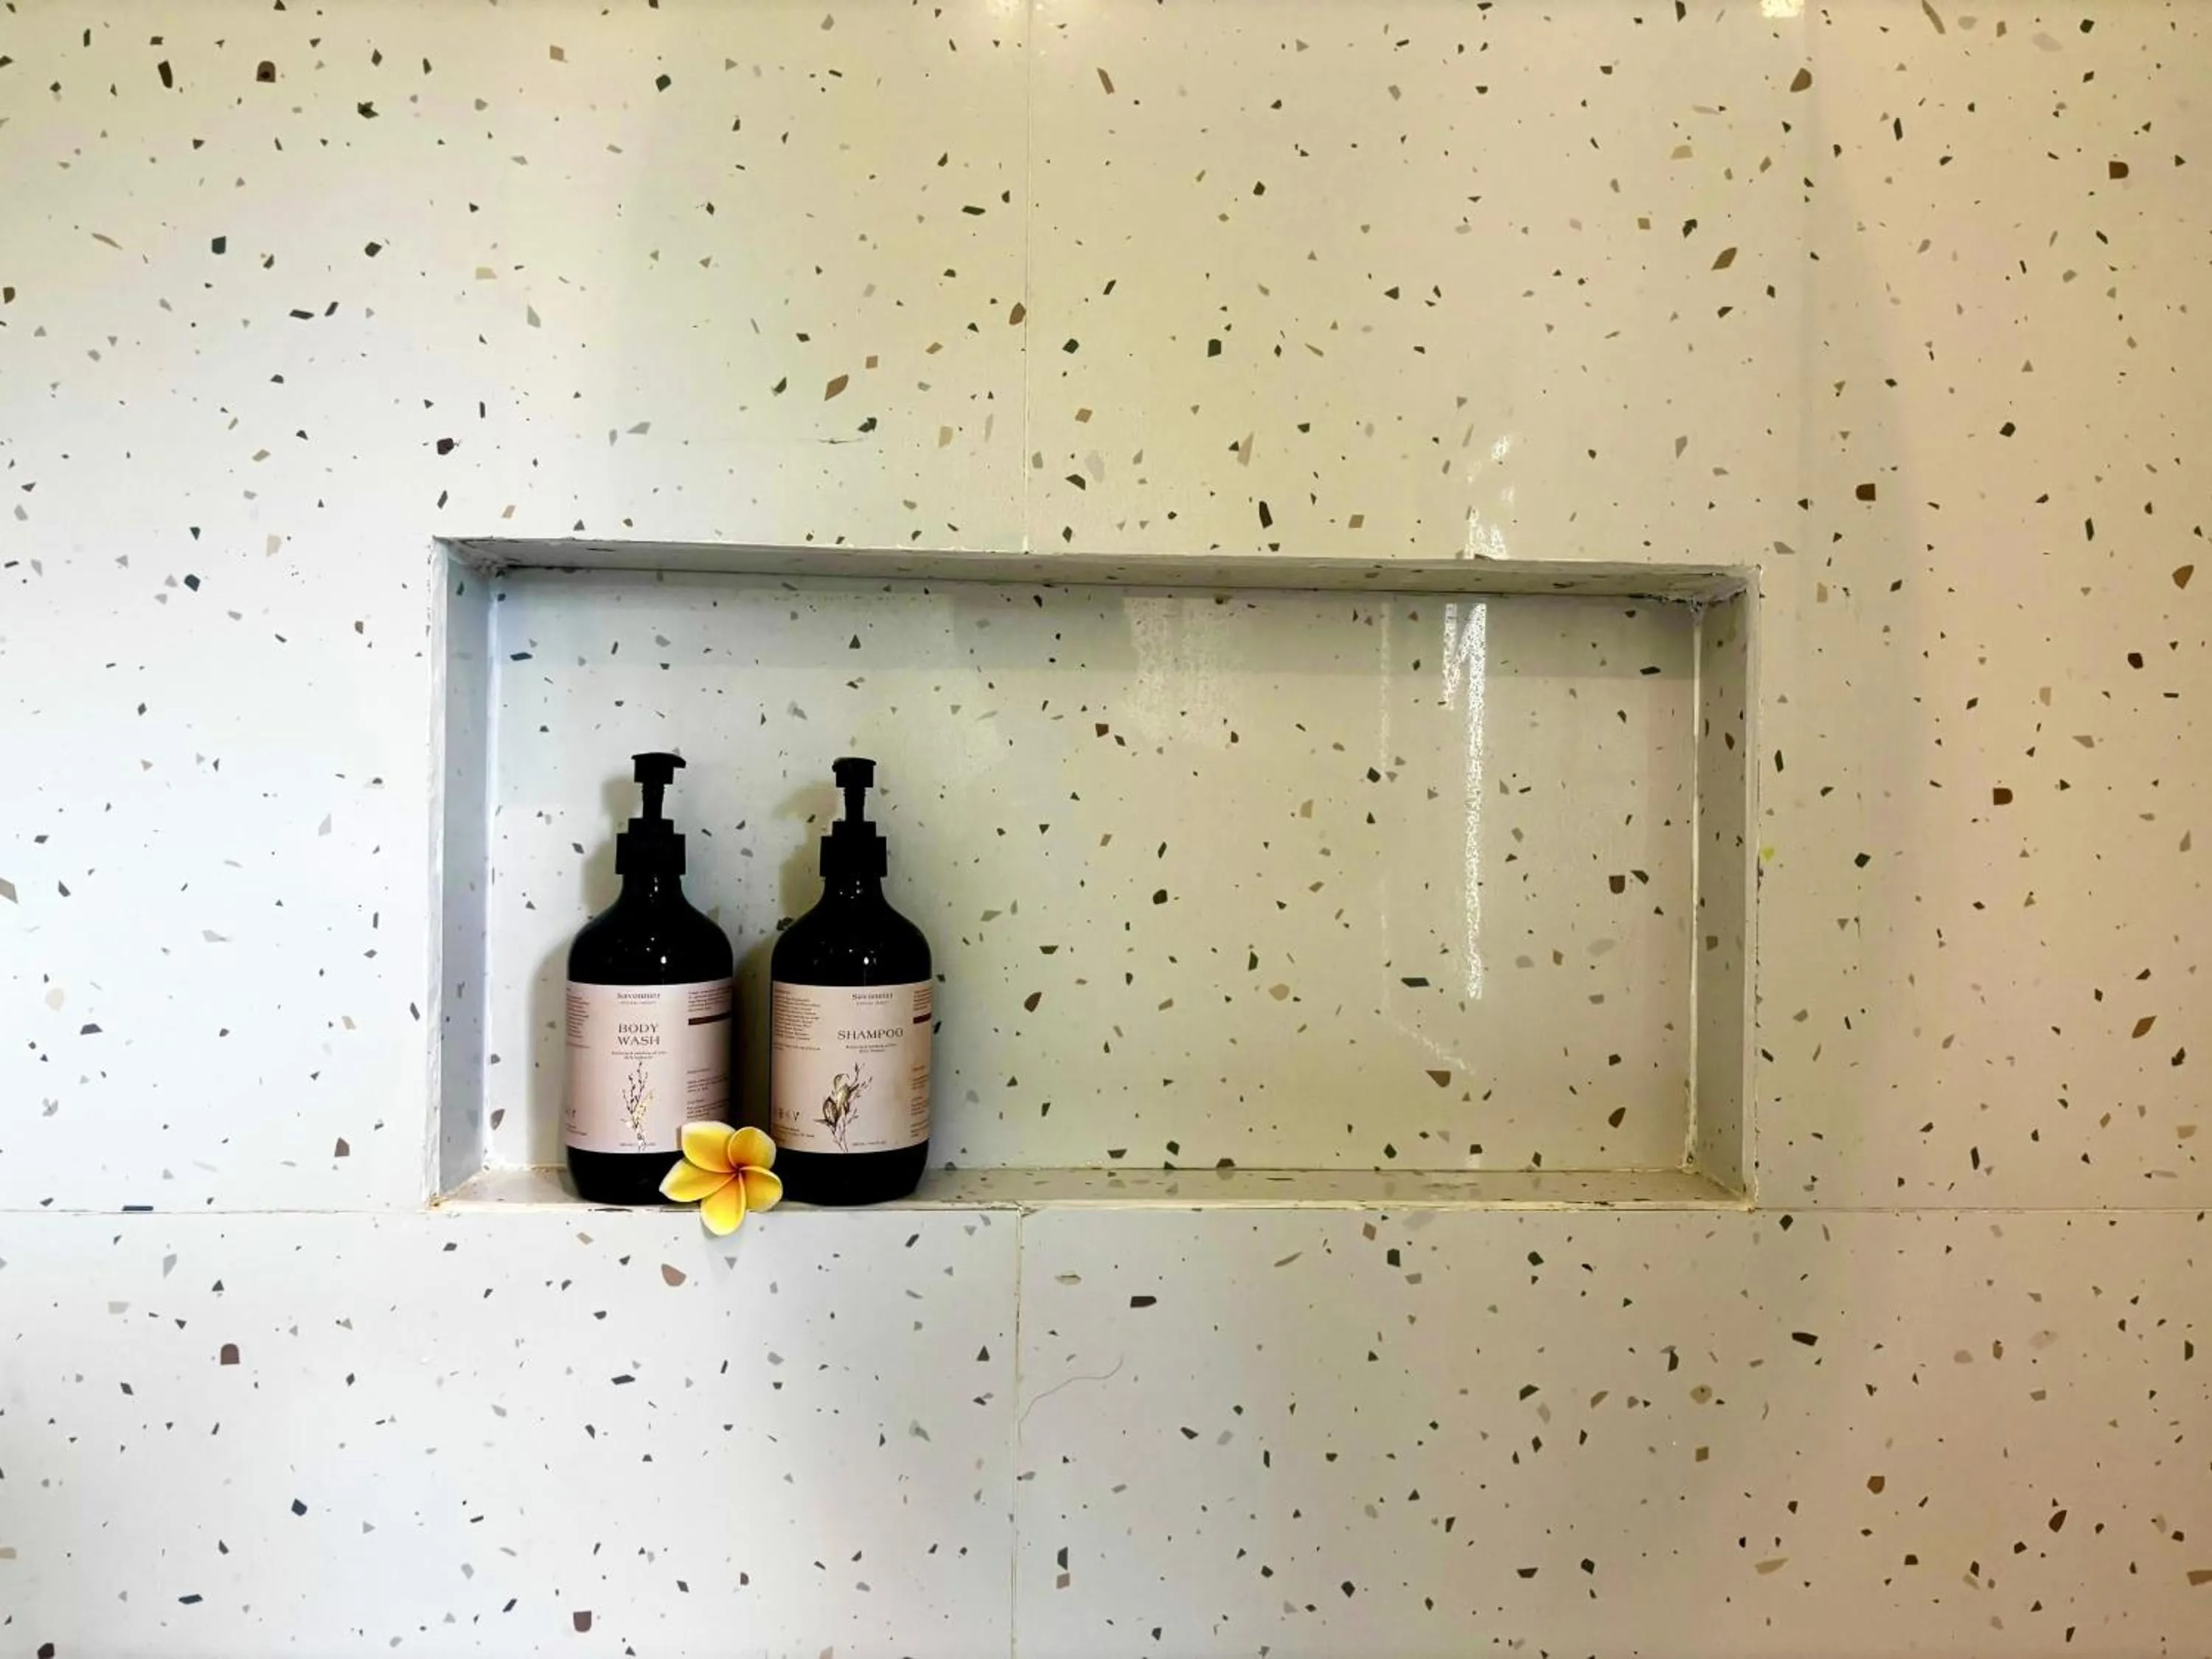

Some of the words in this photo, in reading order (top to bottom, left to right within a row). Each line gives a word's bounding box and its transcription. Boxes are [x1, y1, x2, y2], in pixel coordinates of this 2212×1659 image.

[619, 1023, 659, 1033] BODY
[838, 1028, 903, 1040] SHAMPOO
[617, 1036, 660, 1045] WASH
